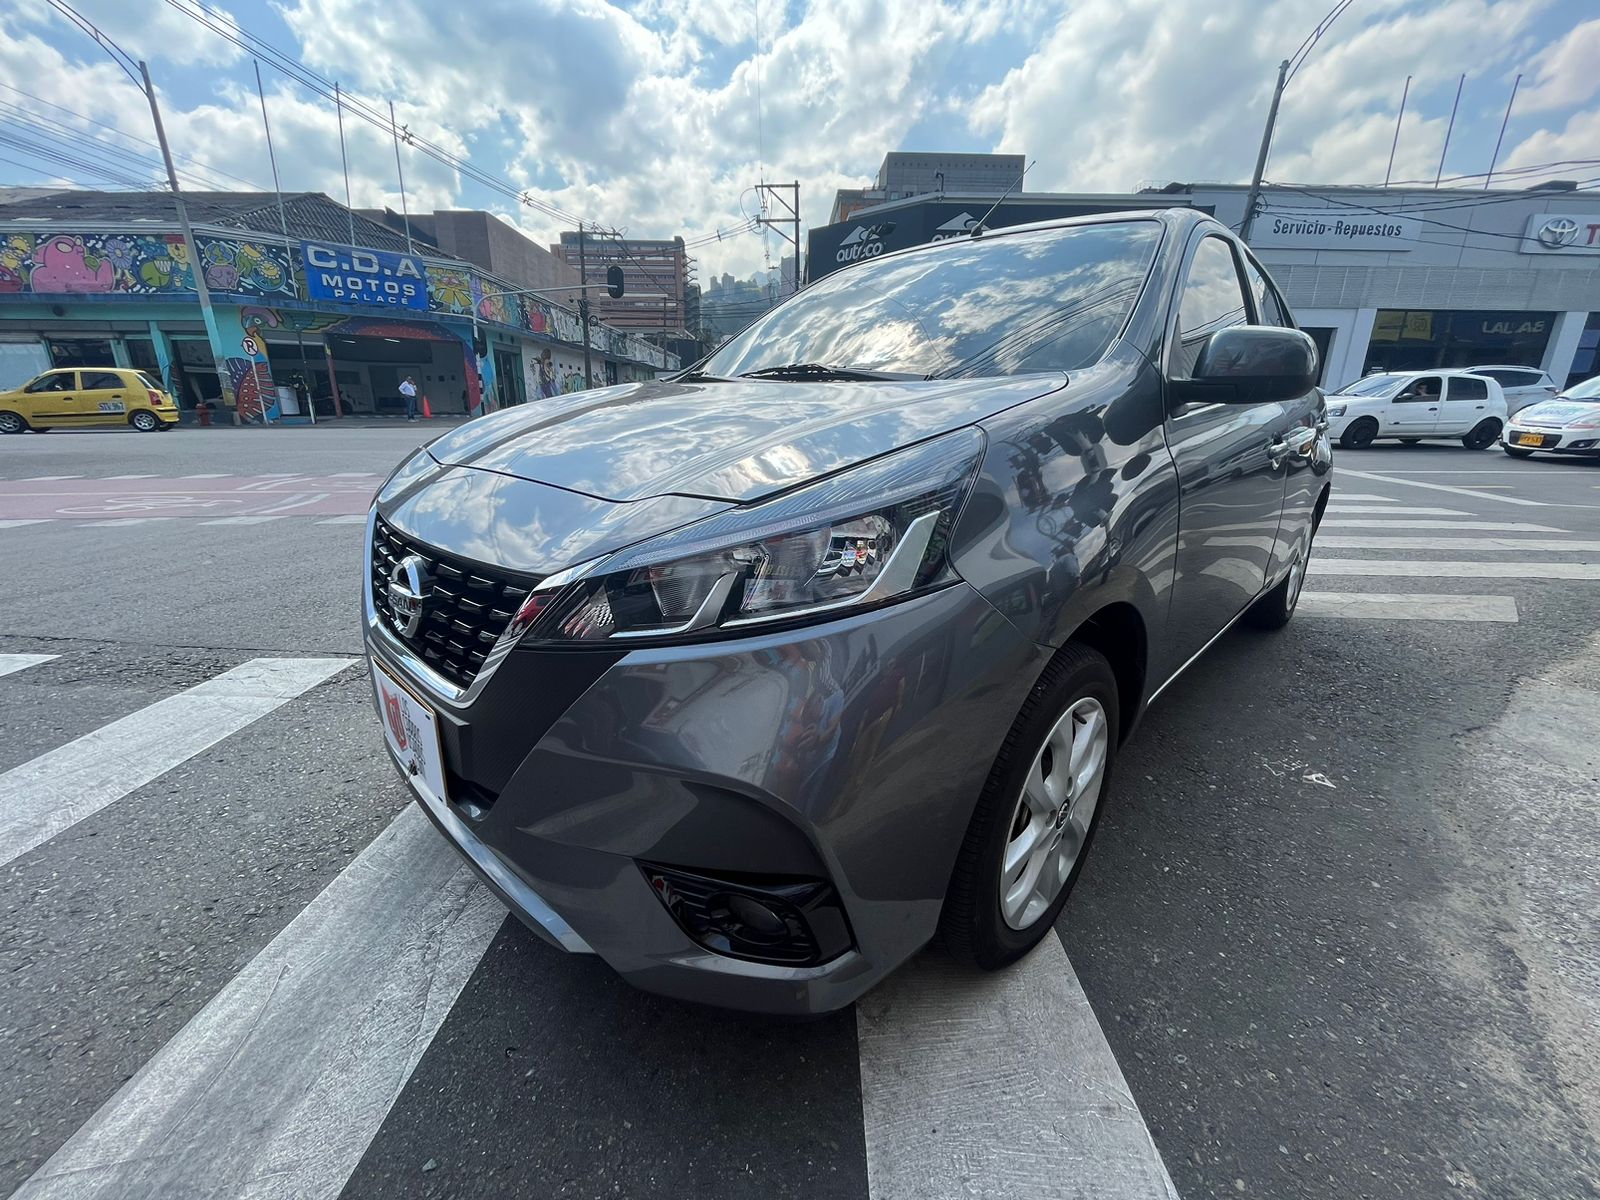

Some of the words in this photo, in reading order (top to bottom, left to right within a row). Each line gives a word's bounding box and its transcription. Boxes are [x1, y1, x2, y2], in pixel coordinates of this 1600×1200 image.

[1273, 218, 1326, 235] Servicio
[1334, 220, 1403, 239] Repuestos
[306, 245, 422, 279] C.D.A
[321, 274, 416, 296] MOTOS
[334, 288, 409, 305] PALACE
